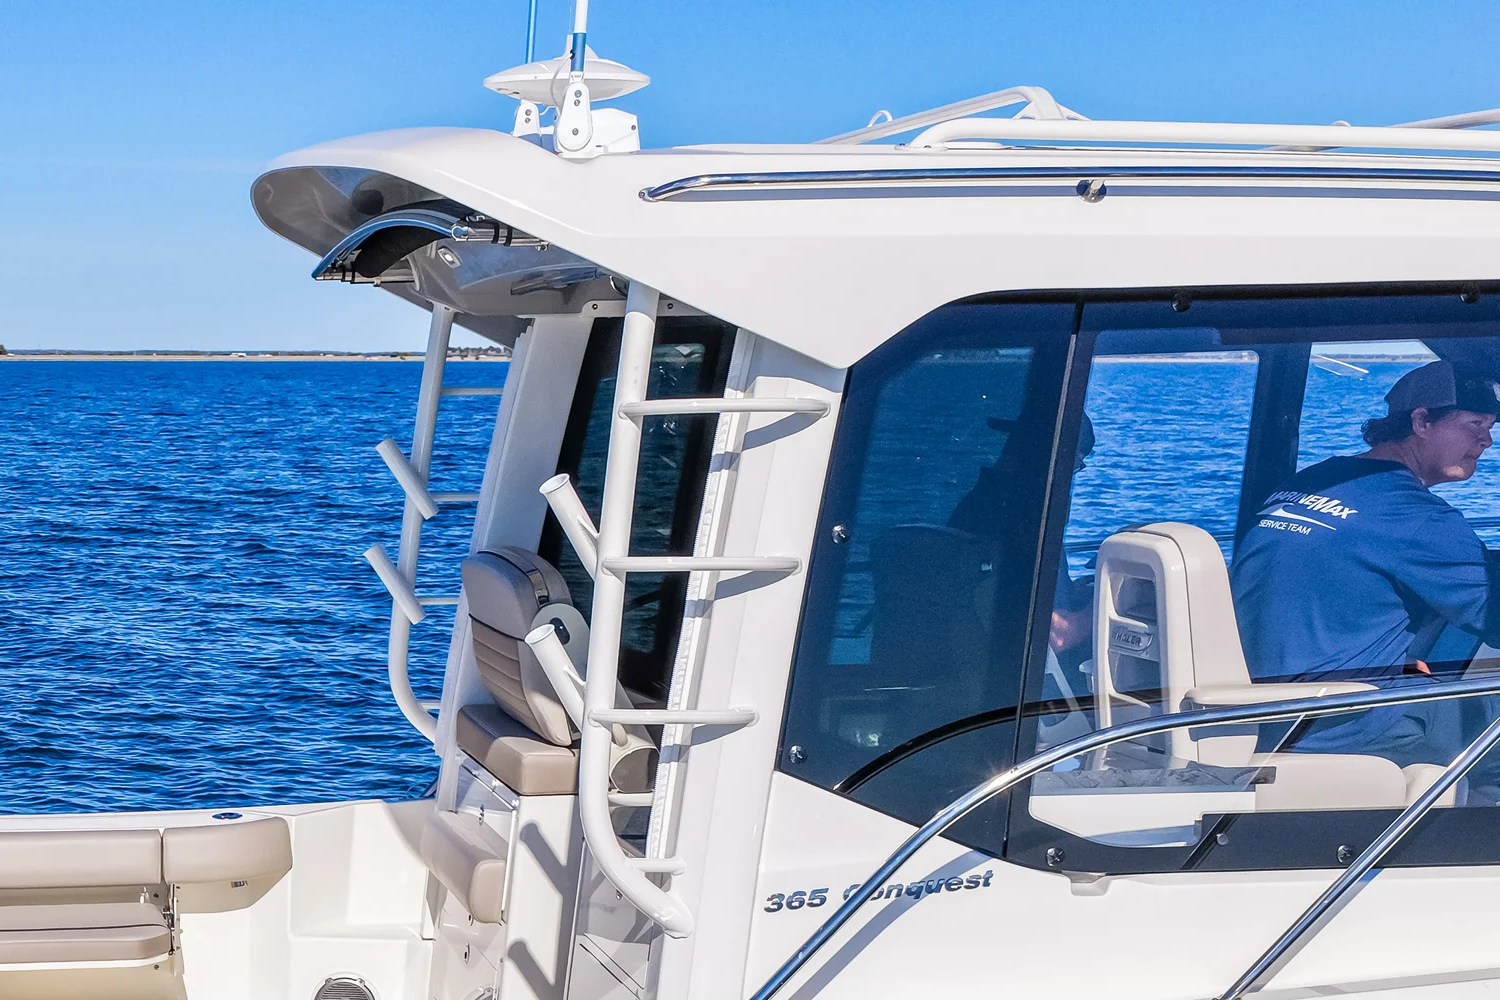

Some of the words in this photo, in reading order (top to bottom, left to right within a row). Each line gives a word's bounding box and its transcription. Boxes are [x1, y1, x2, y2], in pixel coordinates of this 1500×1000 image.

[1258, 519, 1288, 531] SERVICE
[1287, 523, 1312, 535] TEAM
[764, 887, 829, 913] 365
